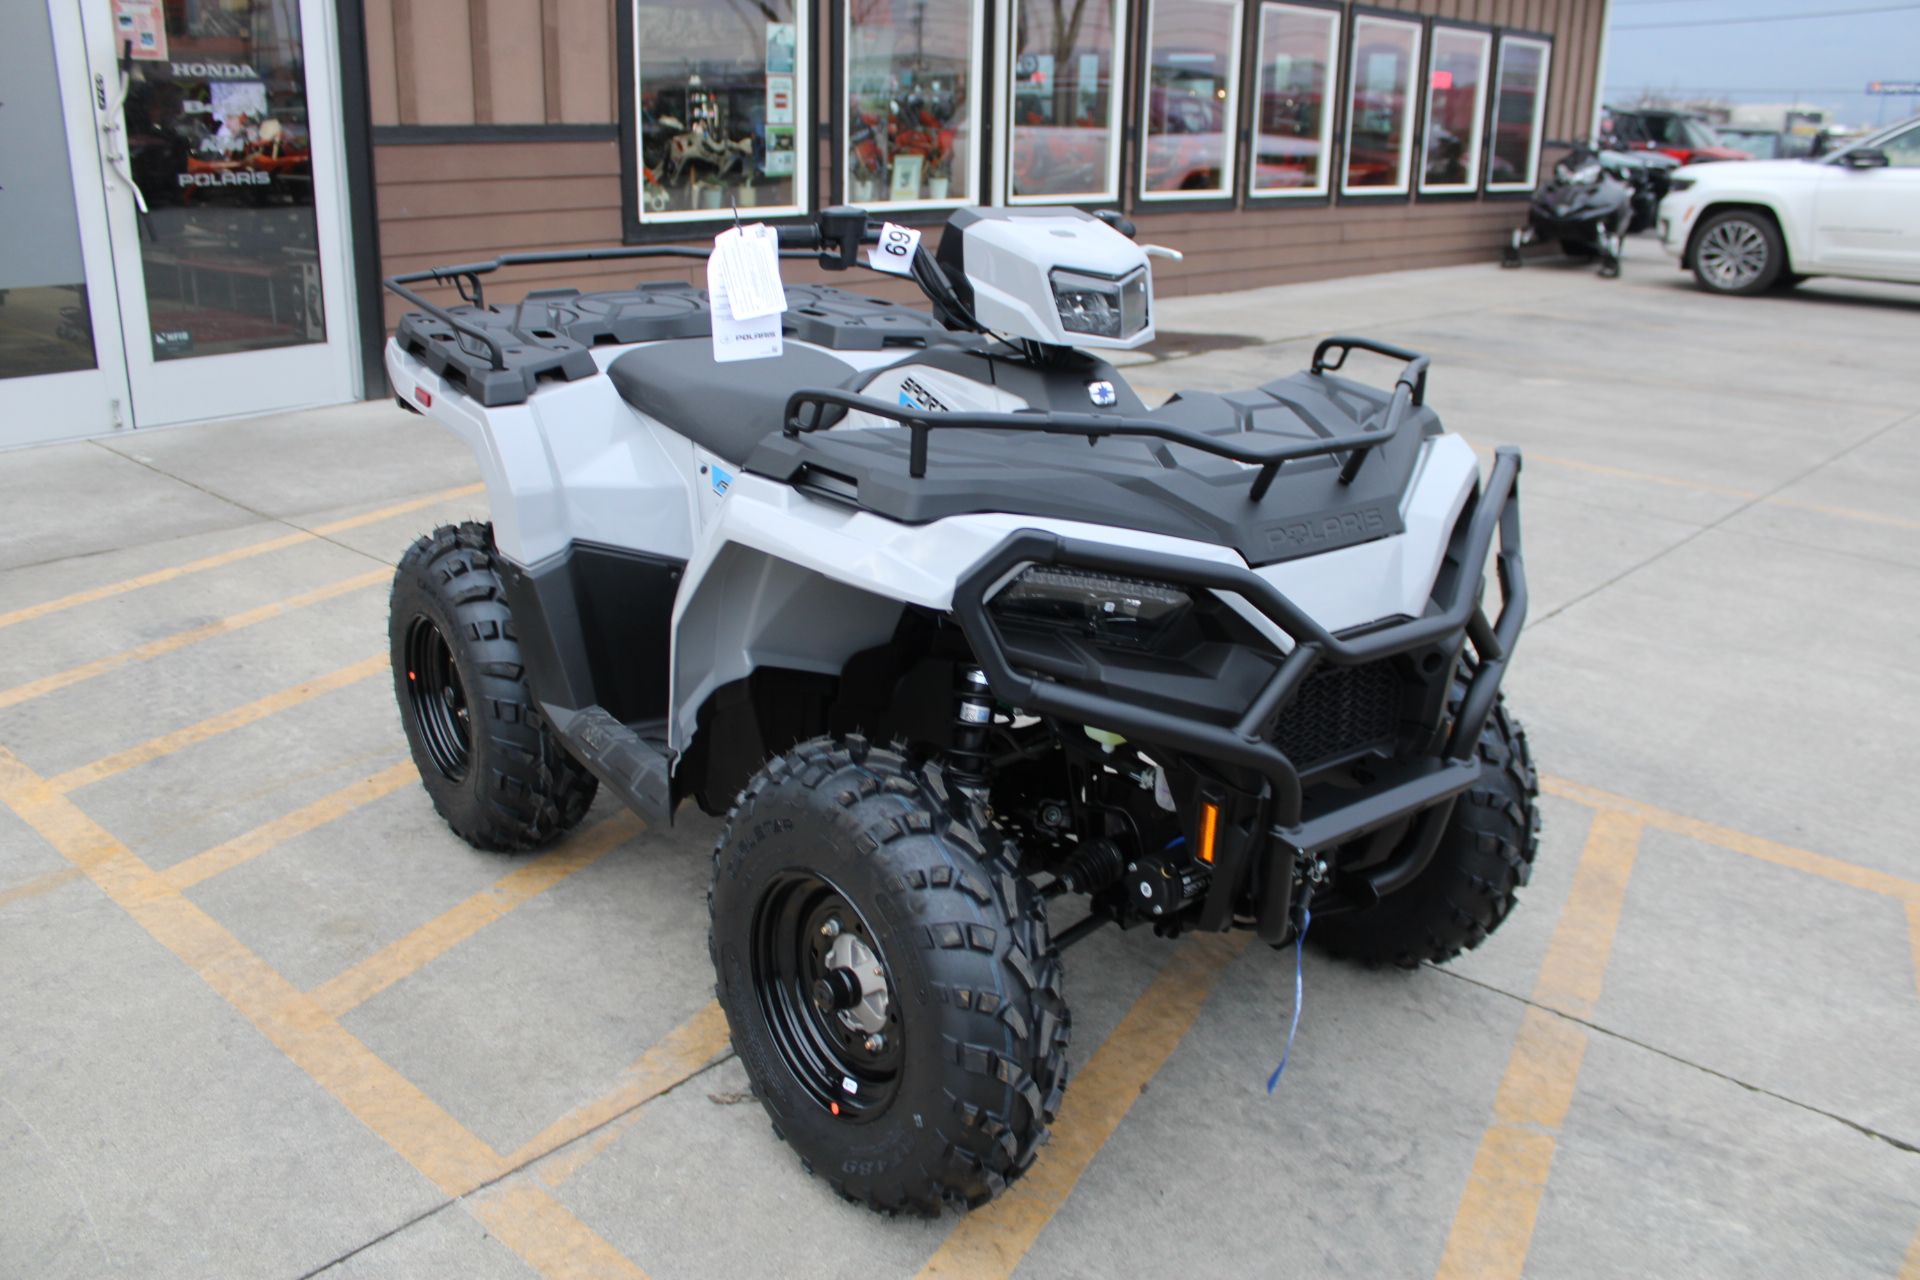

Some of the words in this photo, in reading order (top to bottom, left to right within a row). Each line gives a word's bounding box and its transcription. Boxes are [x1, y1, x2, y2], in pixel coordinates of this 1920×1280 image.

[171, 63, 258, 78] HONDA
[178, 171, 271, 187] POLARIS
[885, 230, 911, 257] 69
